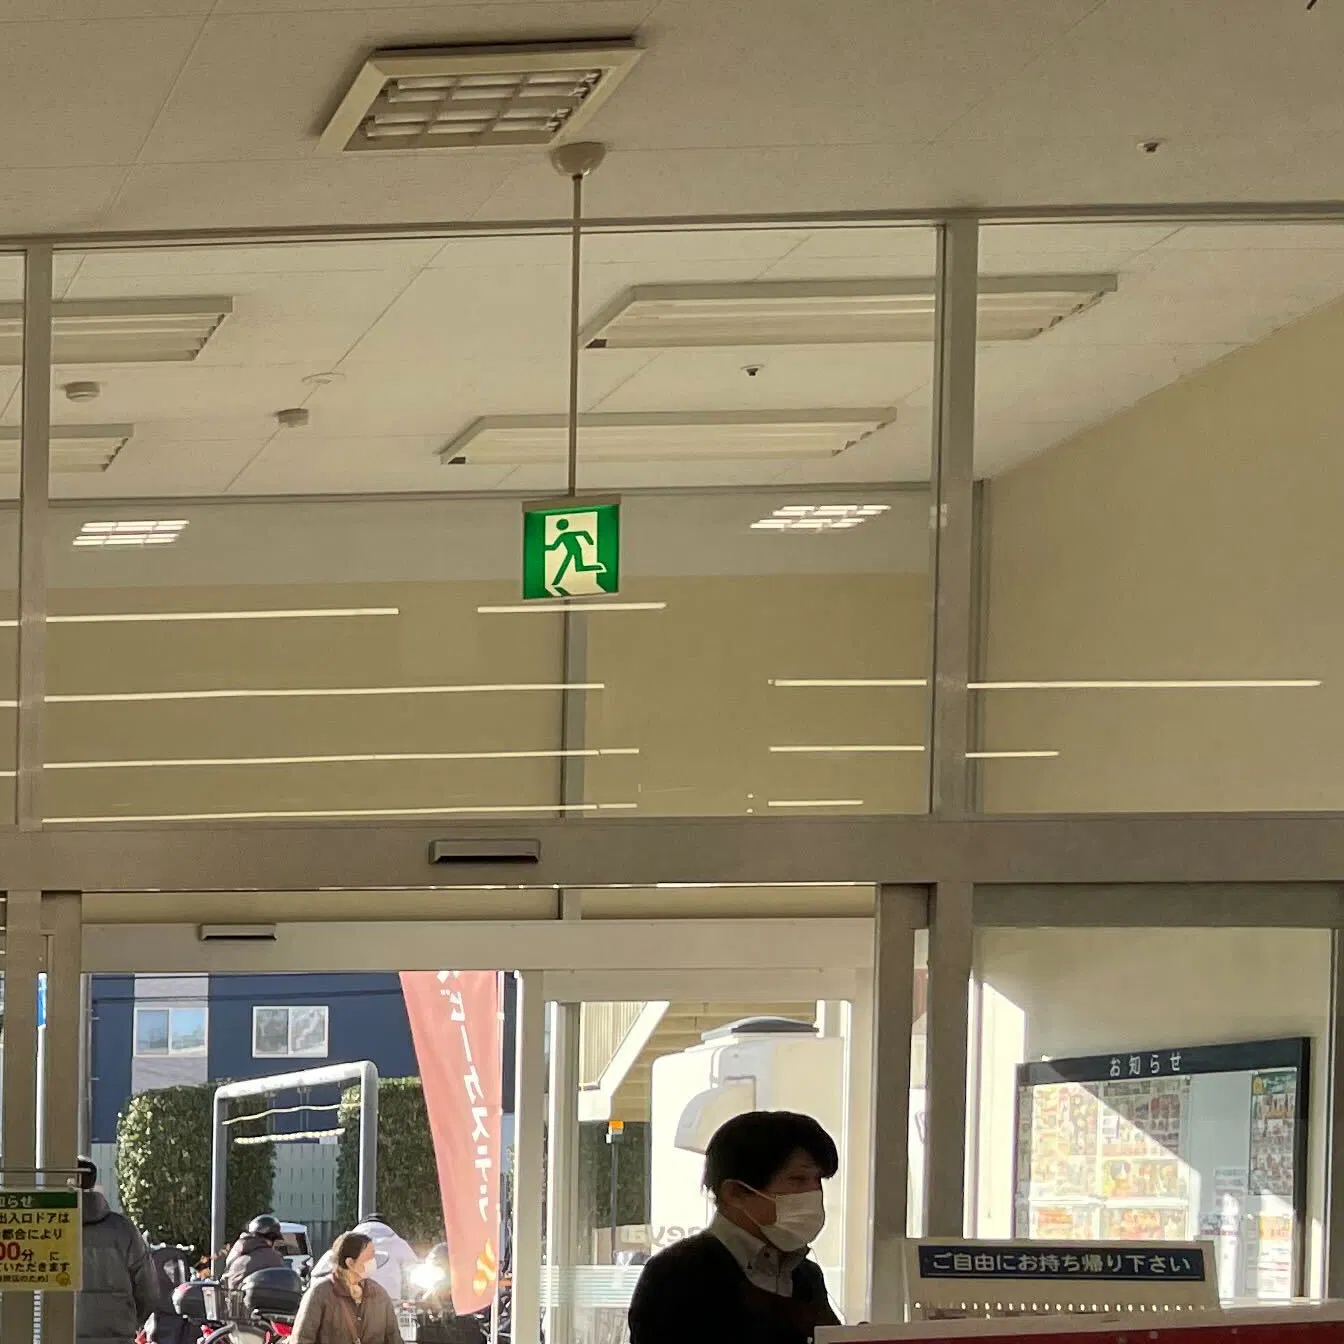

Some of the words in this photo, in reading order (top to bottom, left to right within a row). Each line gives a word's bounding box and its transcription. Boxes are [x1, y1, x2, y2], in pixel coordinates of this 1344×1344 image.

[1108, 1052, 1183, 1078] お知らせ
[932, 1252, 1192, 1274] ご自由にお持ち帰り下さい
